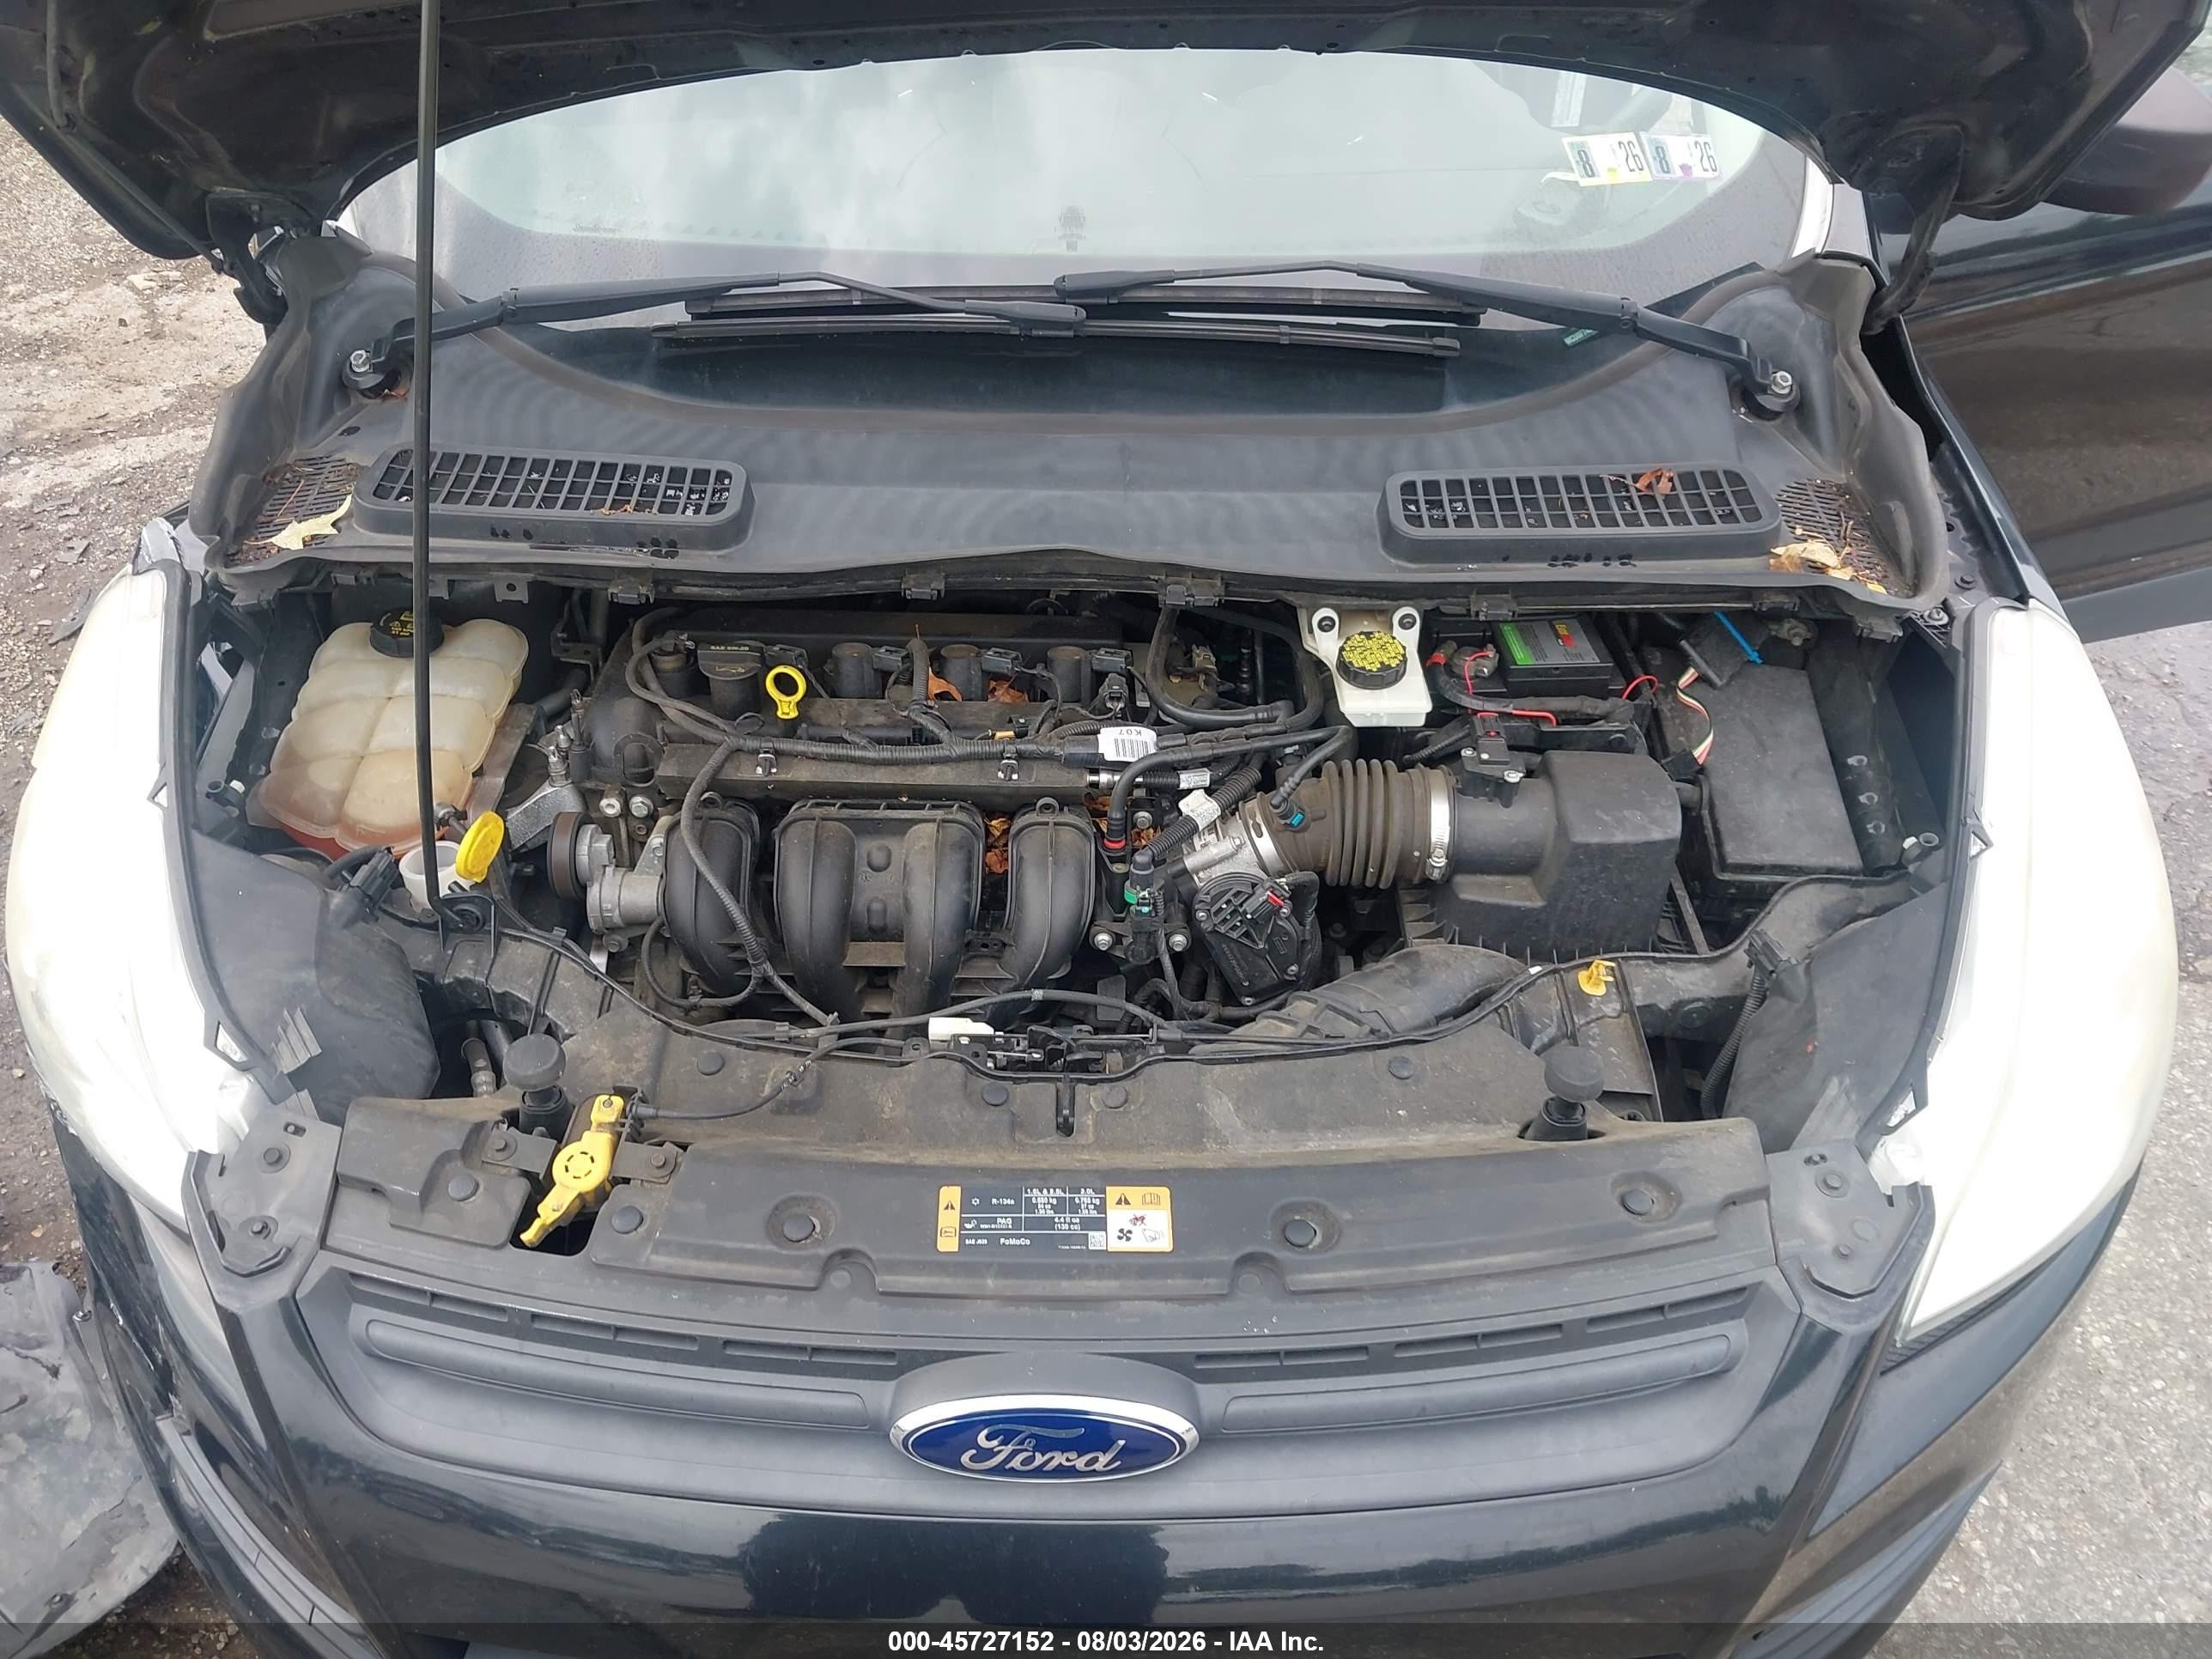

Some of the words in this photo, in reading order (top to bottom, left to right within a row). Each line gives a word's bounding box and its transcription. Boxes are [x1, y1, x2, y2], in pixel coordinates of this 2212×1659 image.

[1577, 149, 1595, 179] 8
[1618, 140, 1644, 173] 26
[1655, 146, 1671, 174] 8
[1693, 141, 1717, 173] 26
[960, 1424, 1126, 1472] Ford
